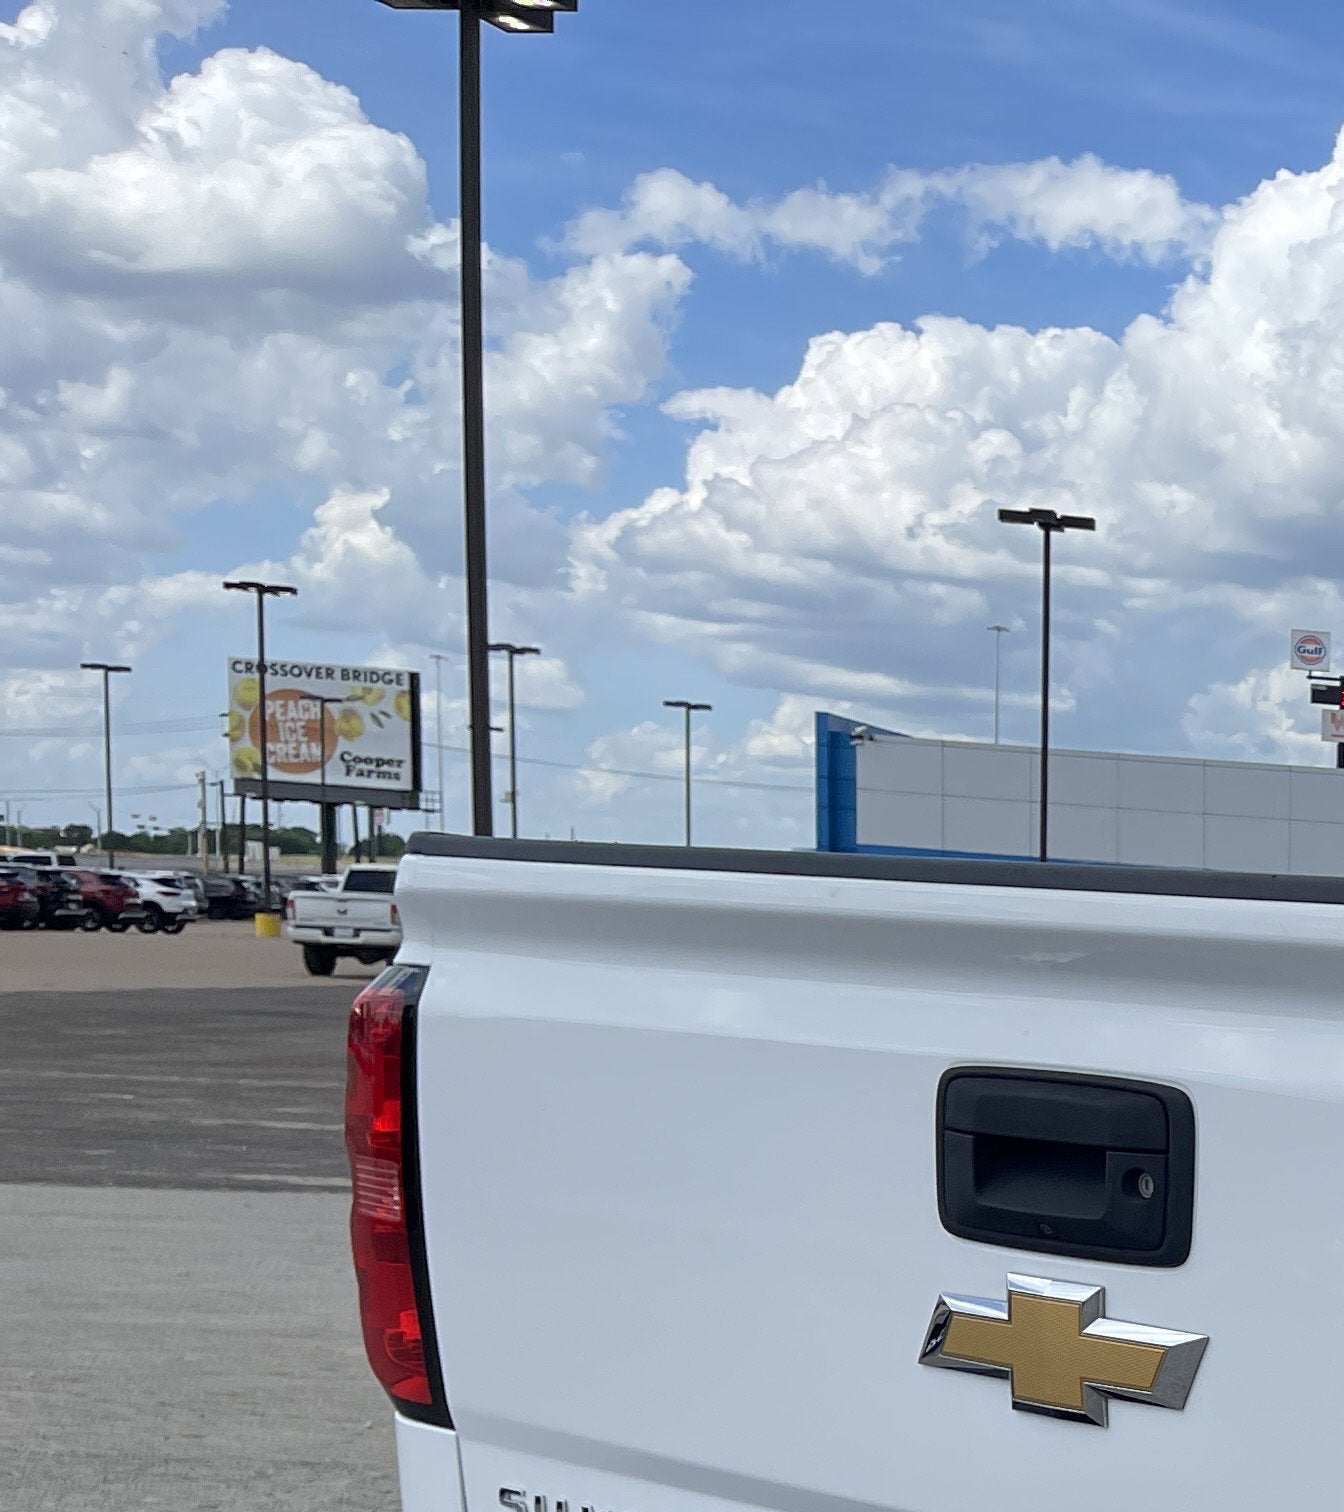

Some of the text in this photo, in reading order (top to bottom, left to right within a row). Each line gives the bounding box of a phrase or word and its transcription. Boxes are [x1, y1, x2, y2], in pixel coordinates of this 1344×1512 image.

[1296, 645, 1322, 656] Gulf
[231, 660, 404, 687] CROSSOVER BRIDGE
[265, 699, 321, 721] PEACH
[278, 721, 309, 742] ICE
[340, 751, 405, 769] Cooper
[345, 765, 401, 781] Farms
